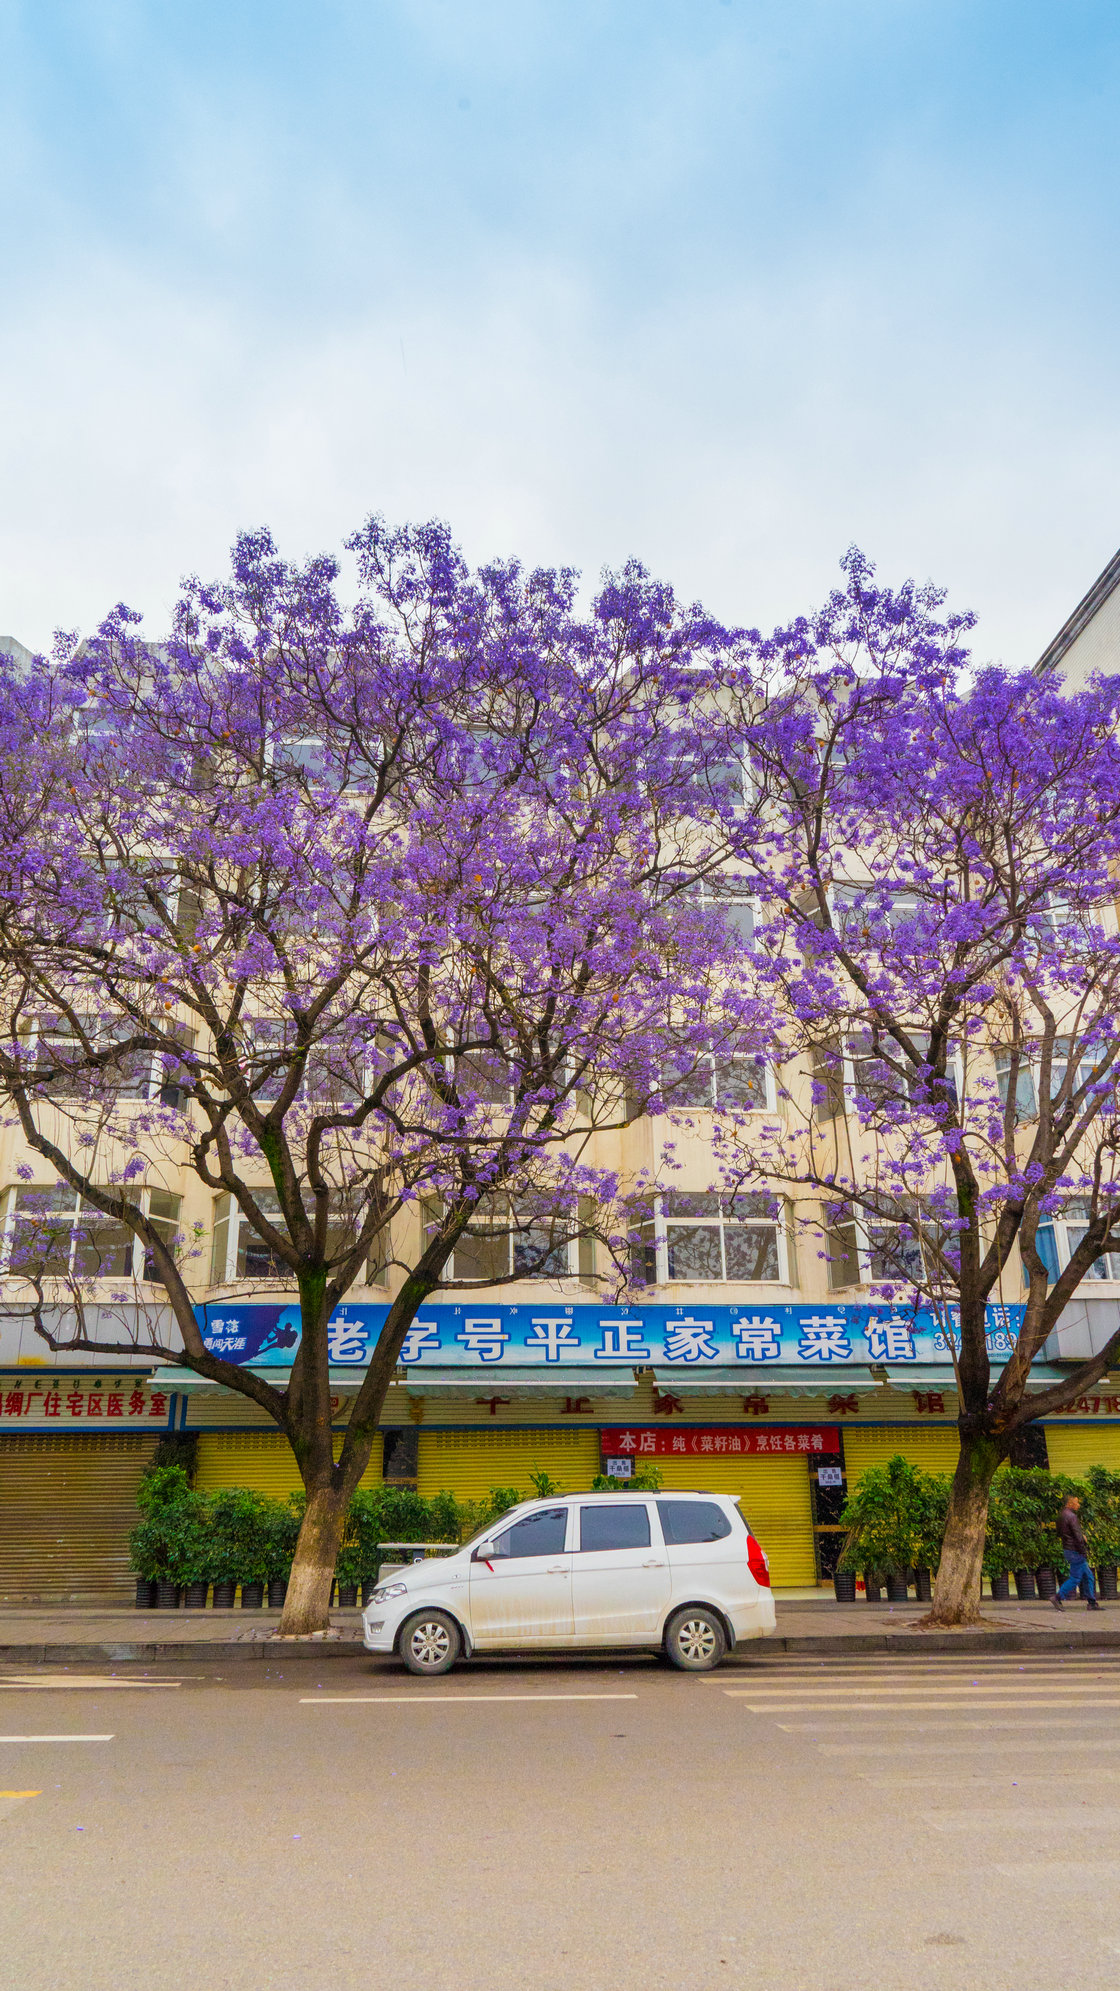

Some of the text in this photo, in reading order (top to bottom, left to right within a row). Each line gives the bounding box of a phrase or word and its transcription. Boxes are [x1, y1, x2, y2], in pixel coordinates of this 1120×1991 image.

[211, 1319, 240, 1334] 雪花
[204, 1337, 247, 1352] 勇闯天涯
[327, 1316, 915, 1362] 老字号平正家常菜馆
[934, 1332, 1018, 1350] 32189
[0, 1390, 167, 1416] 绸厂住宅区医务室
